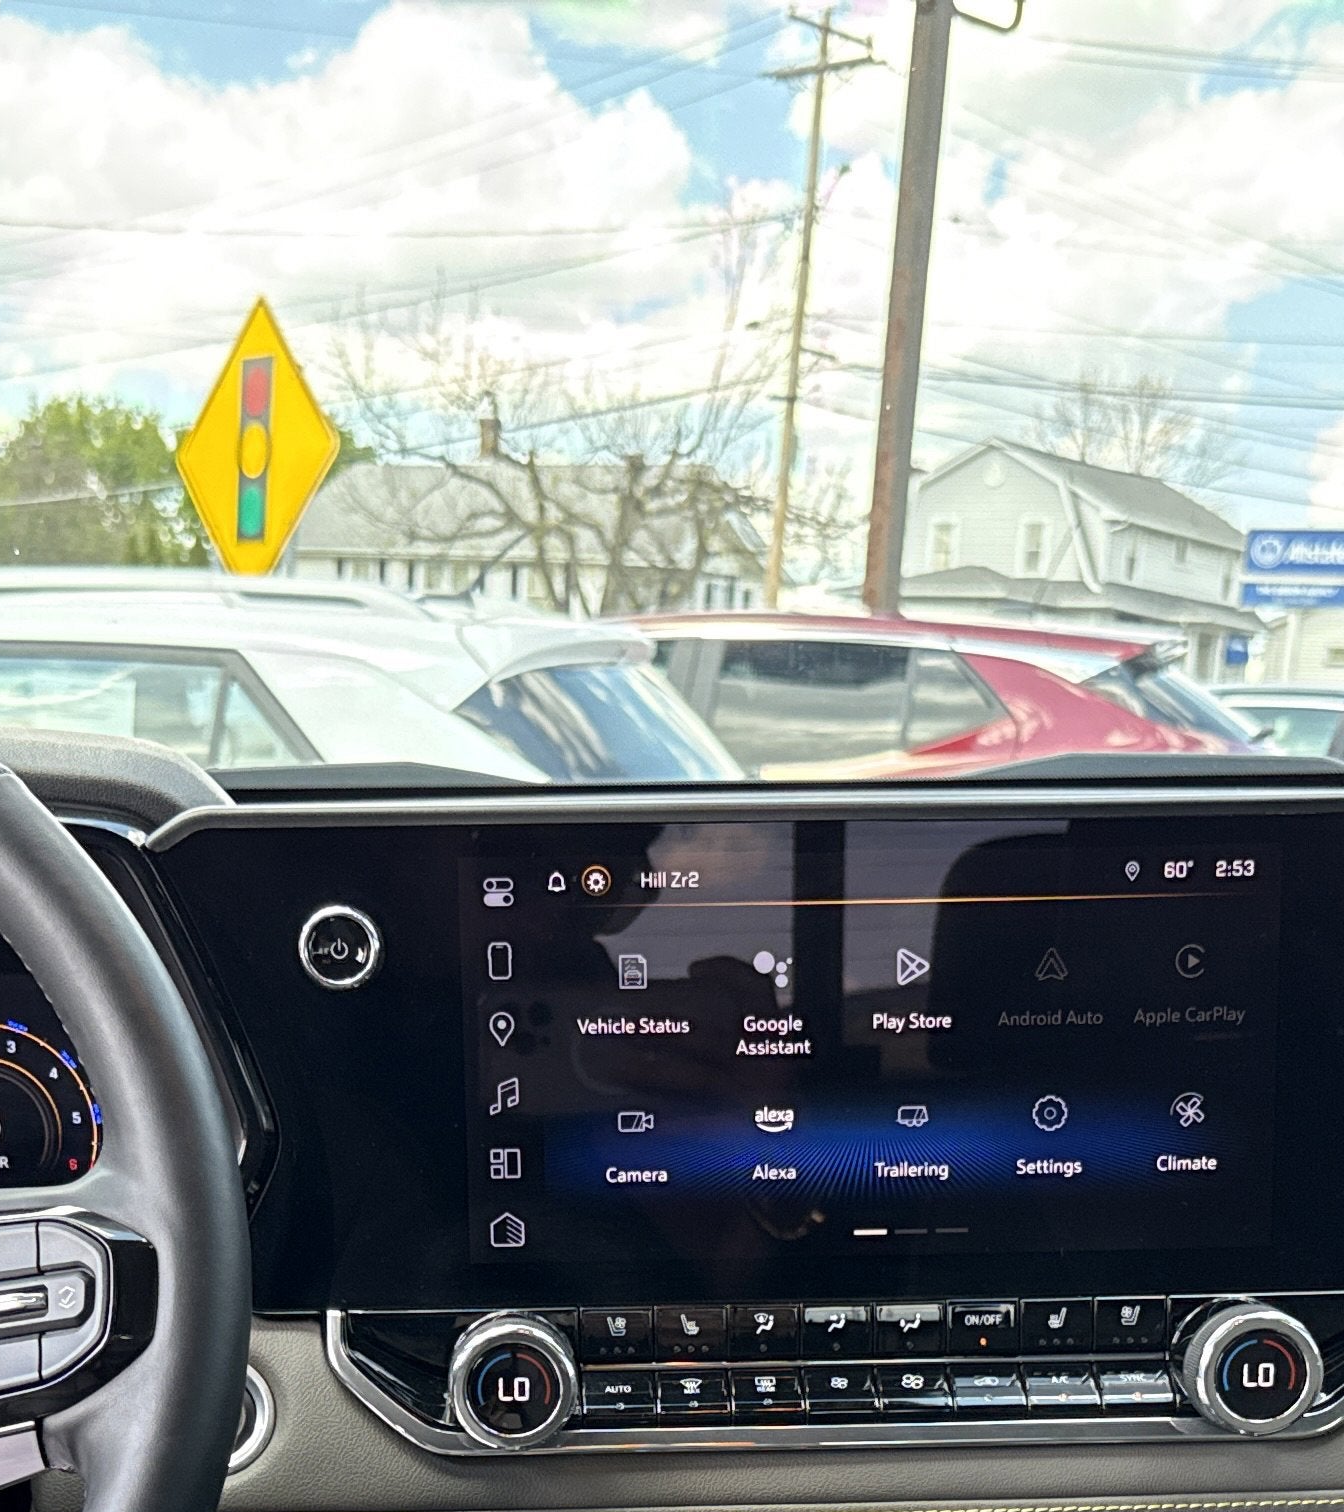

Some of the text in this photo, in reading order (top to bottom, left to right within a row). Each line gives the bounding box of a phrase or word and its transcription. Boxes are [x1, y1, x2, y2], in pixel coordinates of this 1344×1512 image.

[1215, 859, 1255, 878] 2:53
[640, 871, 700, 889] Hill Zr2
[872, 1011, 953, 1034] Play Store
[997, 1009, 1104, 1027] Android Auto
[1133, 1006, 1246, 1025] Apple CarPlay
[577, 1017, 690, 1035] Vehicle Status
[743, 1015, 803, 1036] Google
[7, 1040, 17, 1053] 3
[736, 1039, 812, 1055] Assistant
[49, 1067, 59, 1080] 4
[72, 1111, 82, 1124] 5
[754, 1106, 794, 1123] alexa
[752, 1164, 797, 1181] Alexa
[874, 1161, 949, 1181] Trailering
[1016, 1158, 1083, 1178] Settings
[1156, 1155, 1218, 1172] Climate
[606, 1167, 668, 1183] Camera
[964, 1313, 1003, 1327] ON/OFF
[1242, 1362, 1275, 1388] LO
[497, 1376, 531, 1402] LO
[605, 1384, 632, 1394] AUTO
